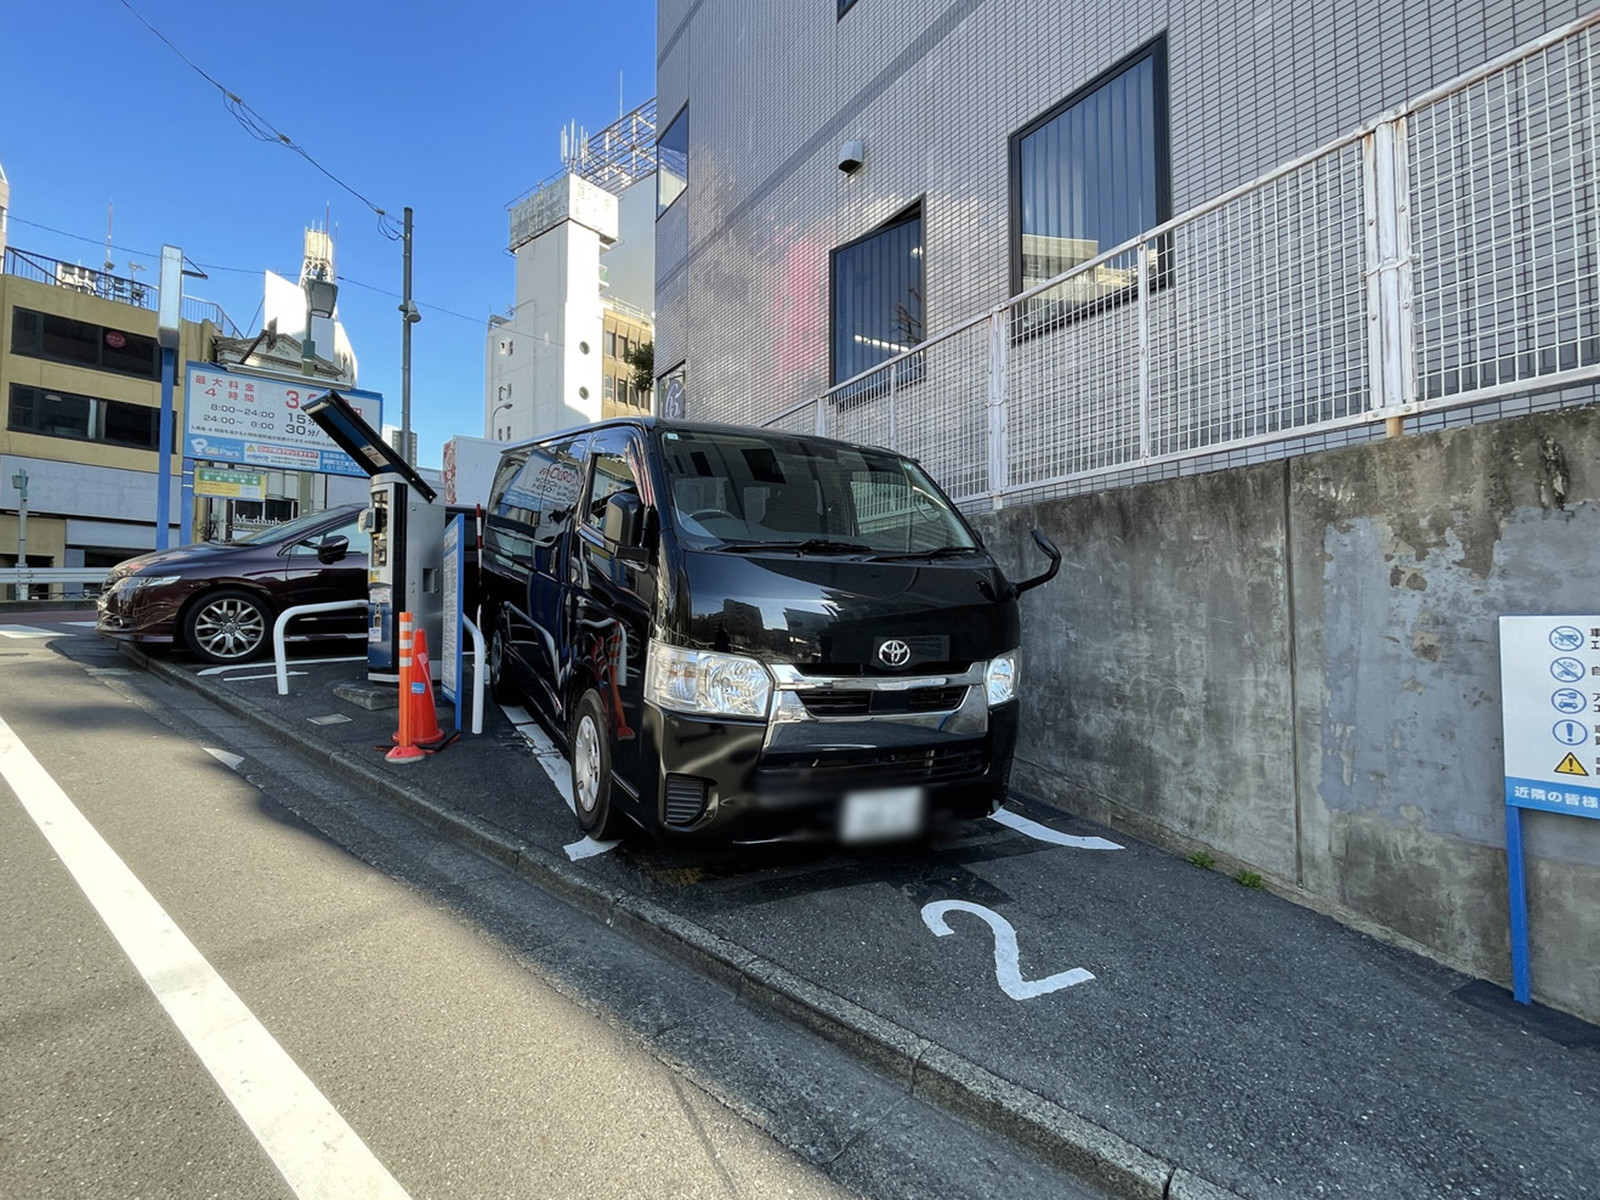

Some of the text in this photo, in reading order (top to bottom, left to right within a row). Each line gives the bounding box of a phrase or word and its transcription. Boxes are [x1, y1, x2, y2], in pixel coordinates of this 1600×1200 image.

[195, 375, 255, 393] 最大料金
[204, 388, 217, 397] 4
[228, 391, 255, 403] 時間
[1514, 786, 1599, 809] 近隣の皆様
[921, 900, 1096, 1000] 2
